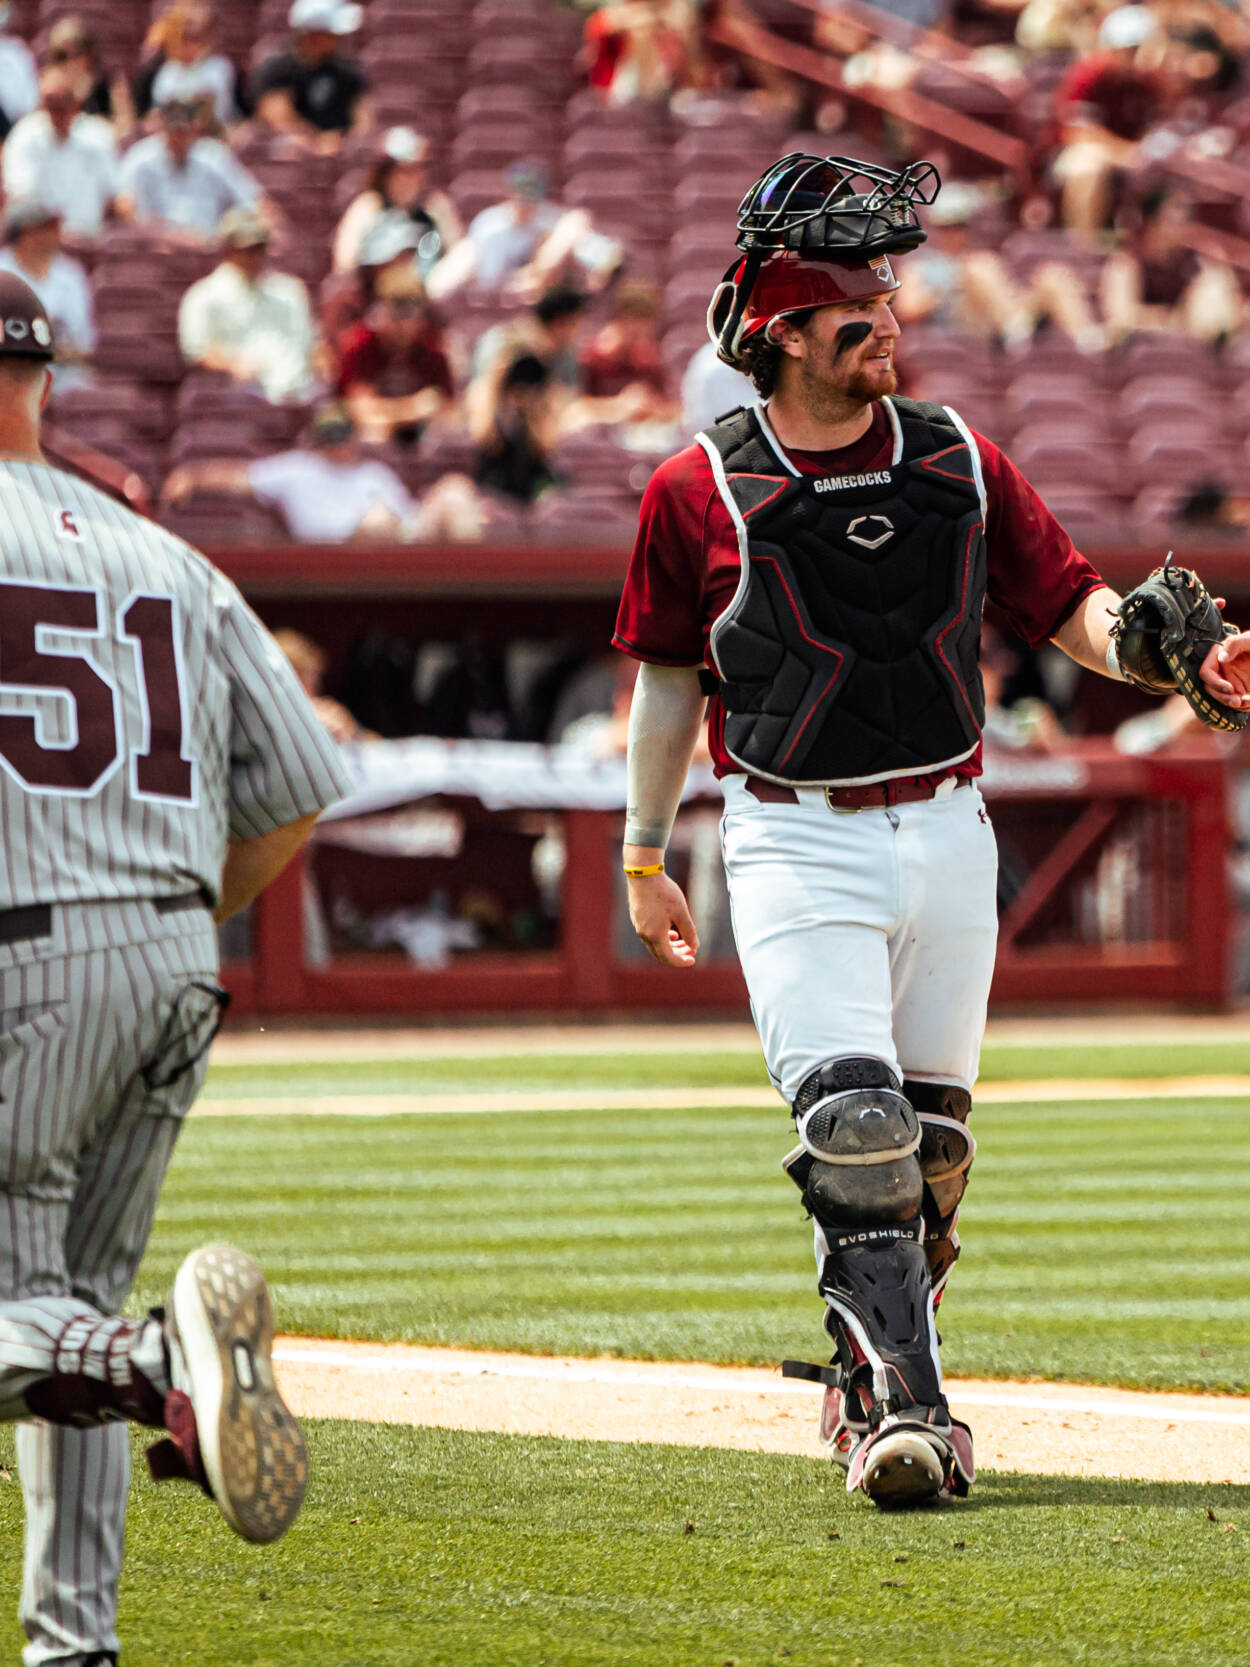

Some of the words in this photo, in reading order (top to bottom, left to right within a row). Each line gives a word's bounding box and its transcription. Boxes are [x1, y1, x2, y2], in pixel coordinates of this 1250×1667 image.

[813, 470, 892, 493] GAMECOCKS
[0, 579, 200, 809] 51
[838, 1229, 914, 1246] EVOSHIELD
